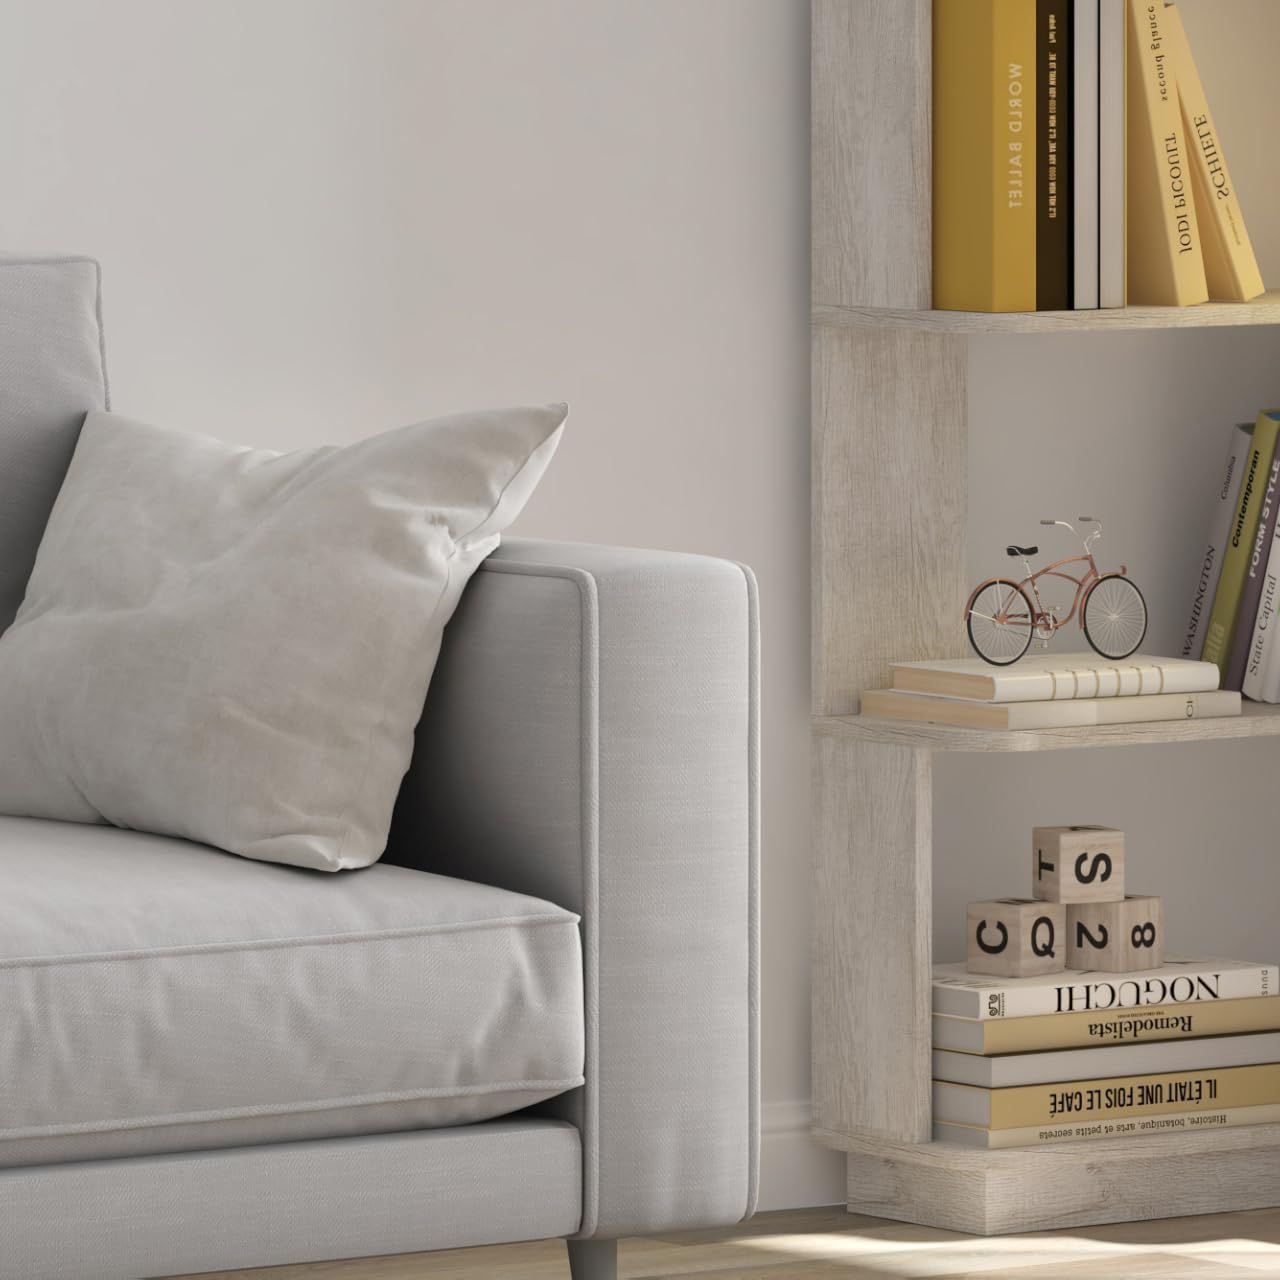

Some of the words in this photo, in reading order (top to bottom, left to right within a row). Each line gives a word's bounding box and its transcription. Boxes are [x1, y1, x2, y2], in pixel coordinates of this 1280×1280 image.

[1232, 450, 1260, 548] Contemporan
[1250, 524, 1266, 579] FORM
[1262, 460, 1280, 519] STYLE
[1182, 544, 1216, 656] WASHINGTON
[1249, 635, 1264, 677] State
[1258, 574, 1278, 631] Capital
[1038, 848, 1054, 880] T
[1074, 852, 1112, 884] S
[976, 919, 1008, 955] C
[1031, 916, 1055, 958] Q
[1076, 921, 1108, 950] 2
[1131, 922, 1156, 949] 8
[1054, 974, 1221, 1013] NOGUCHI
[1088, 1016, 1193, 1039] Remodelista
[1086, 1090, 1101, 1110] LE
[1105, 1086, 1134, 1108] FOIS
[1138, 1084, 1163, 1105] UNE
[1166, 1080, 1202, 1105] ÉTAIT
[1206, 1079, 1217, 1099] IL
[1049, 1091, 1082, 1118] CAFÉ
[1076, 1125, 1102, 1137] petits
[1104, 1125, 1114, 1134] et
[1116, 1123, 1136, 1132] arts
[1138, 1118, 1185, 1130] botanique,
[1187, 1114, 1227, 1125] Histoire,
[1039, 1129, 1073, 1140] secrets
